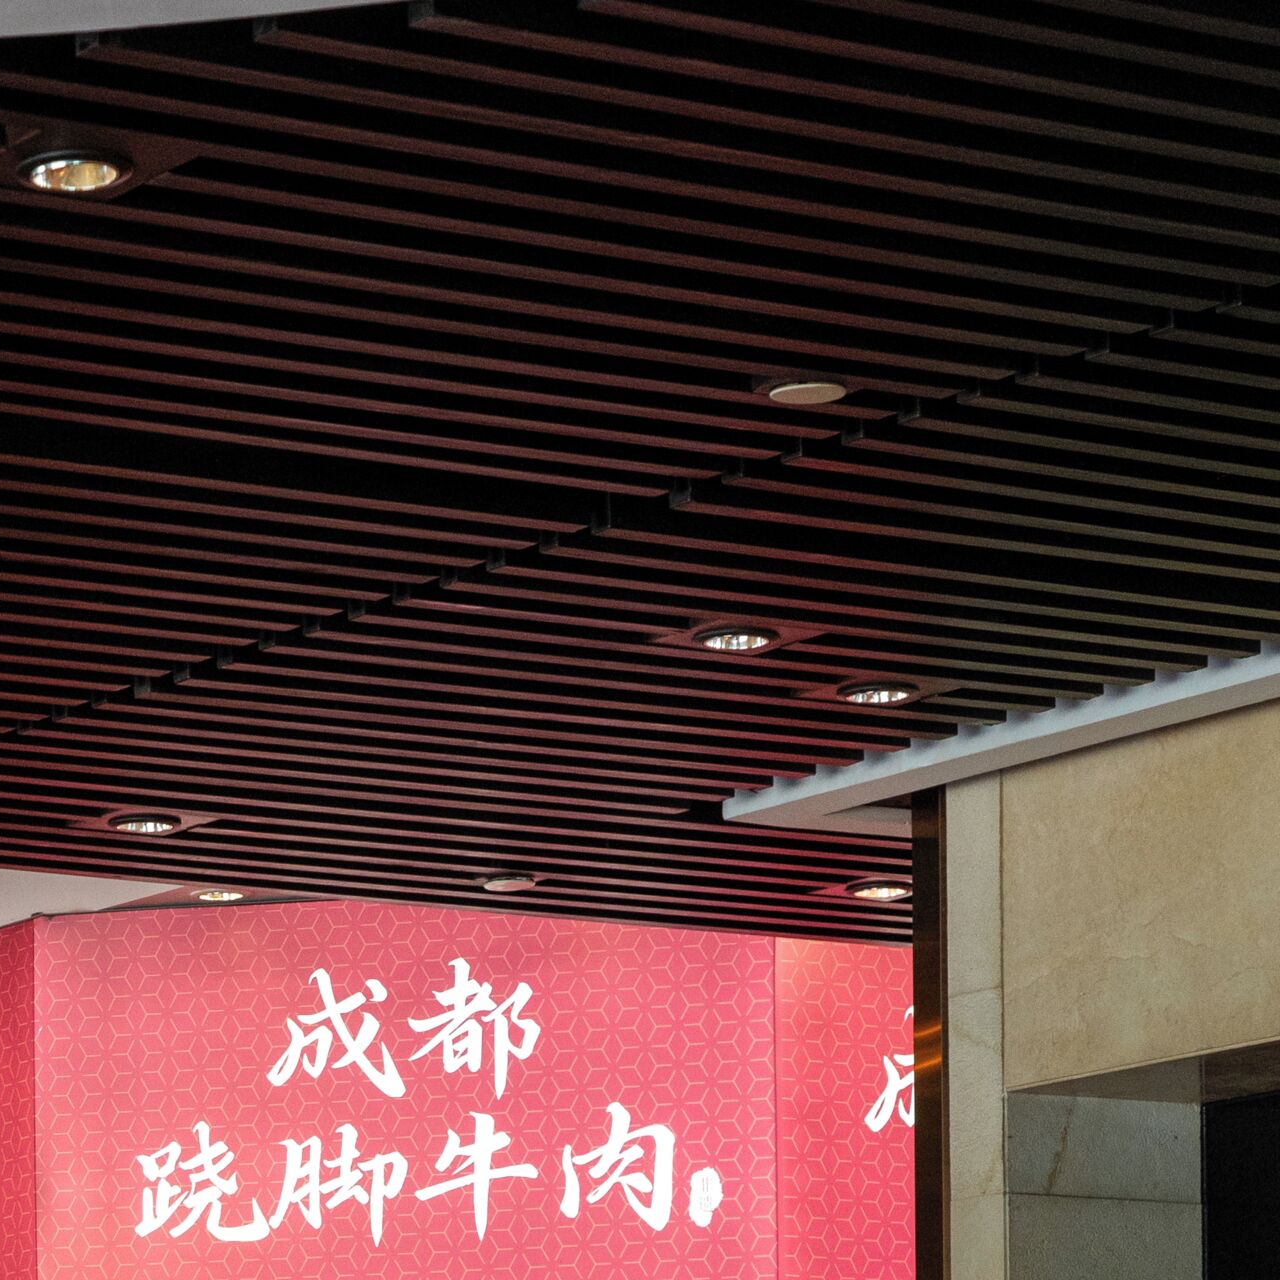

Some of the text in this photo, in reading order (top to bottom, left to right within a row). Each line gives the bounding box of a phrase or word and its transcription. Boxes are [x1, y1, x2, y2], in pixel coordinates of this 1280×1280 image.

[266, 957, 541, 1100] 成都
[133, 1101, 675, 1247] 跷脚牛肉
